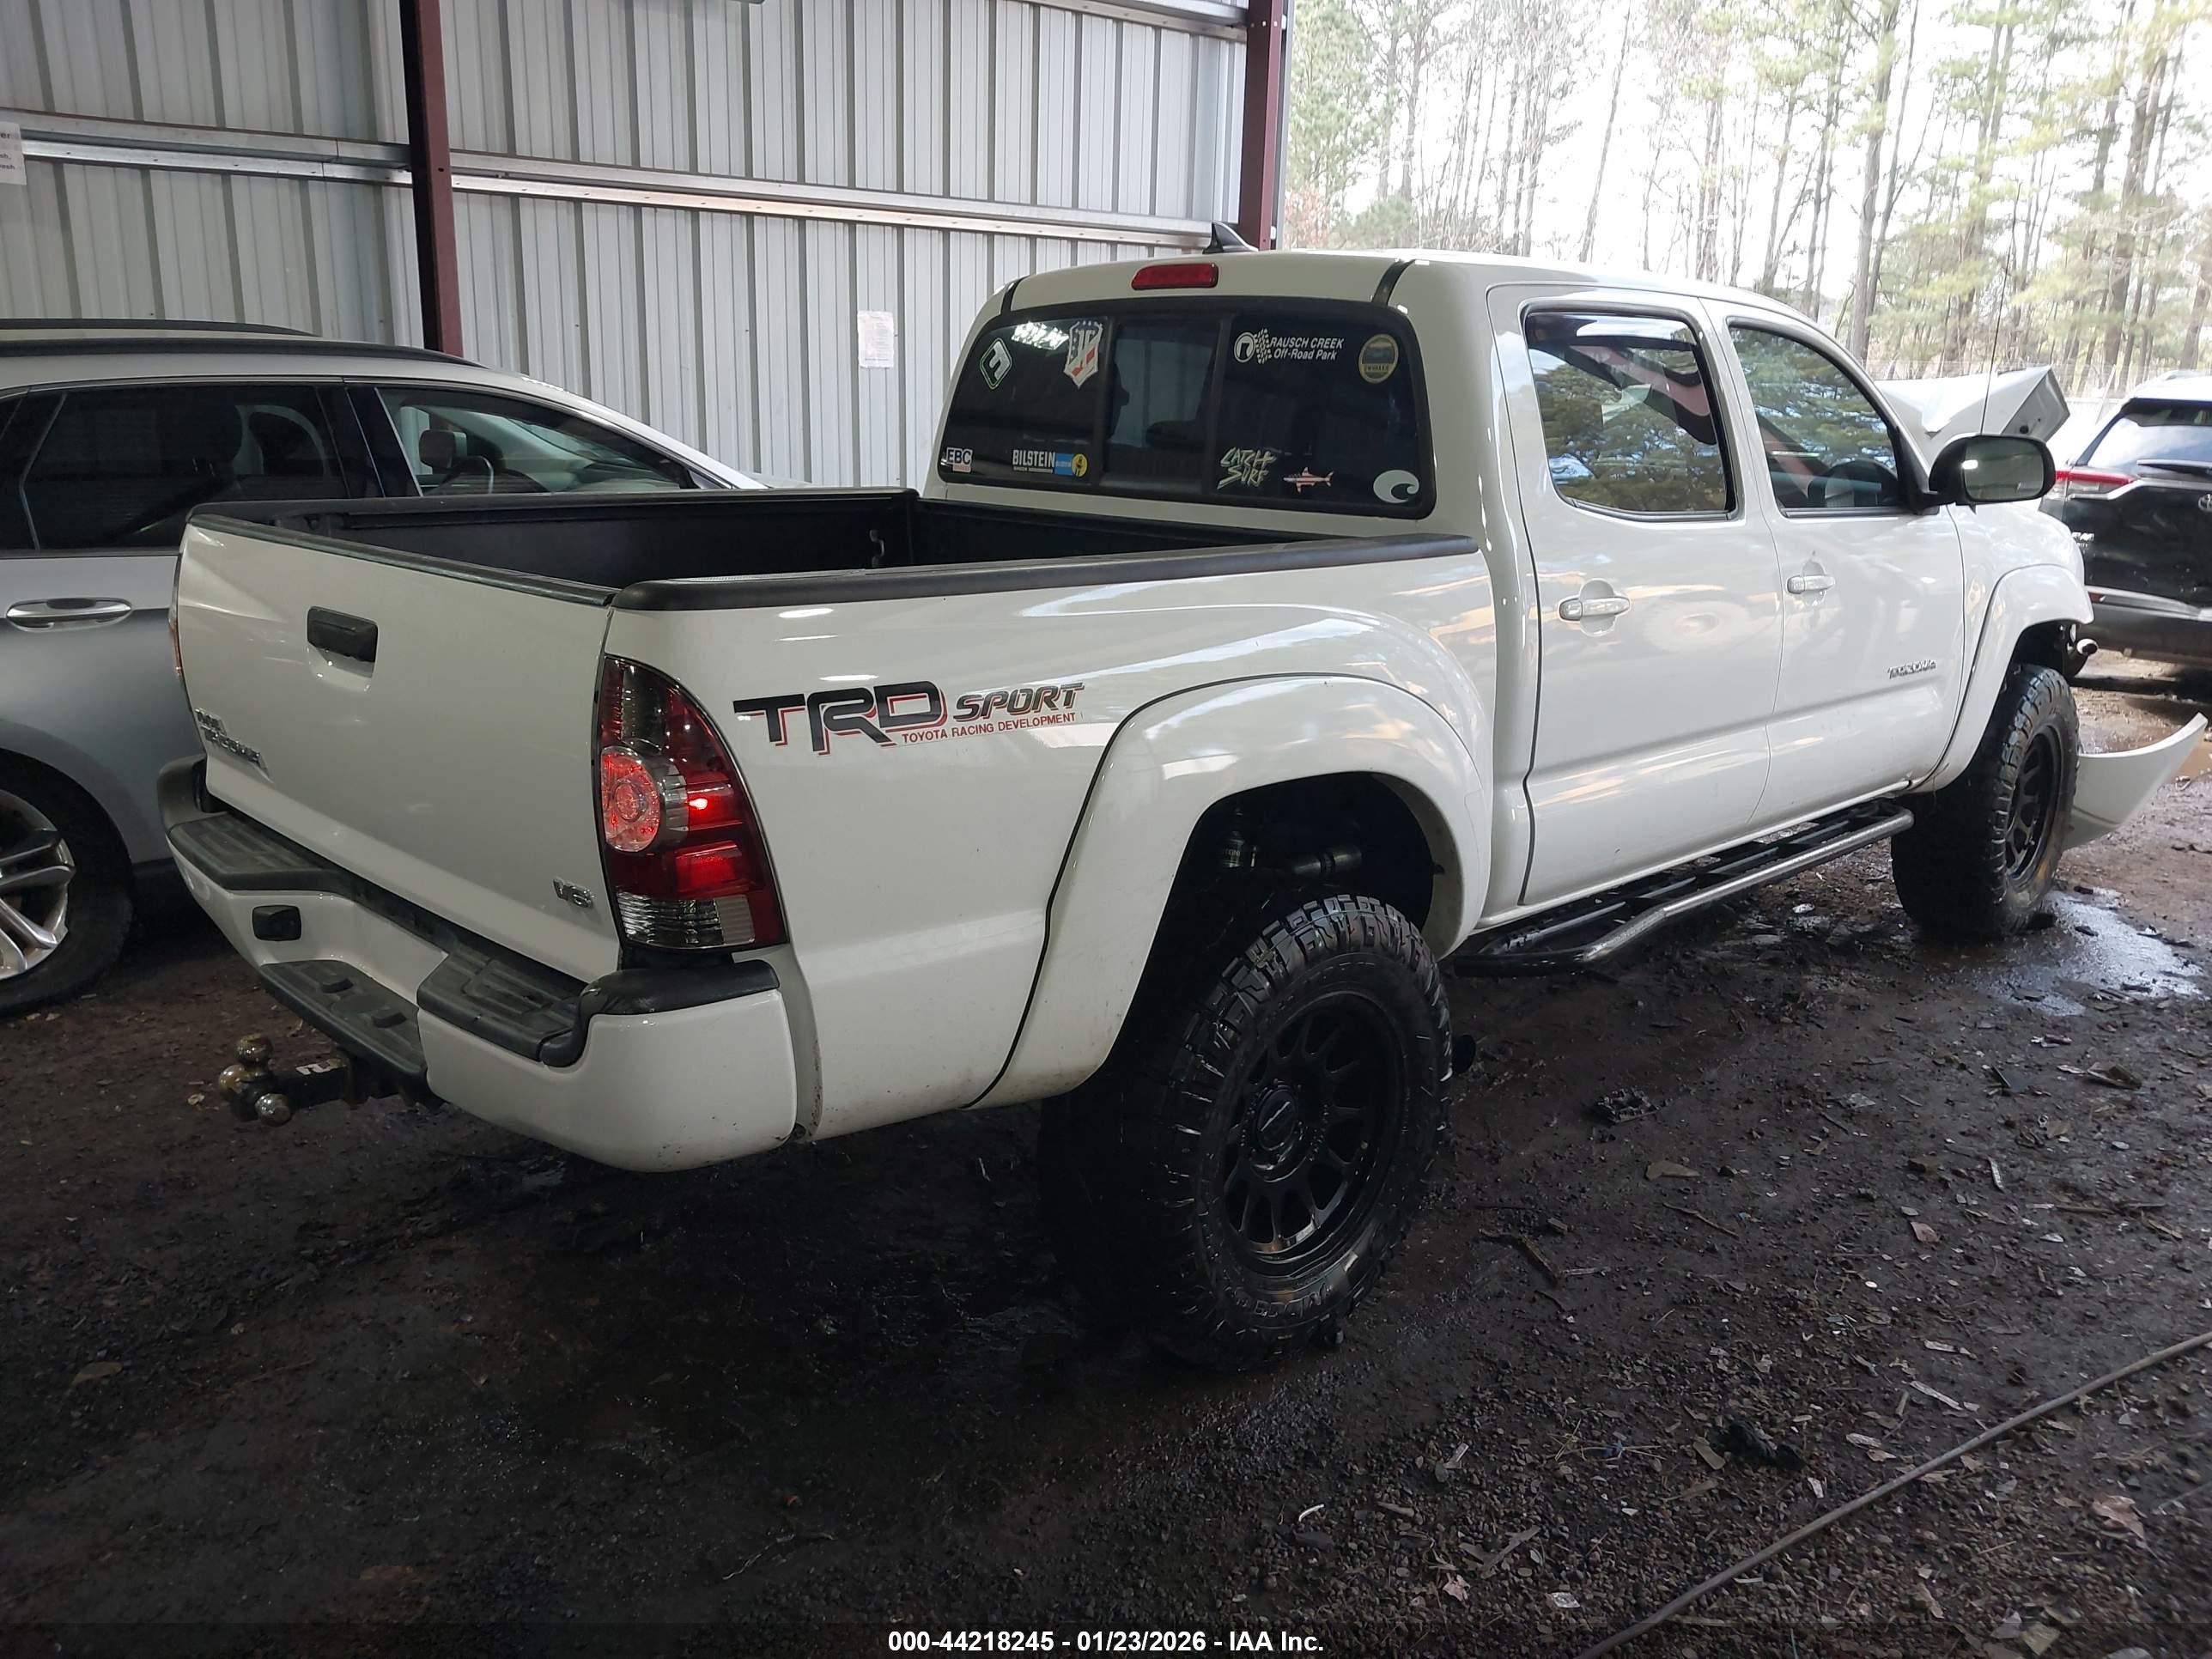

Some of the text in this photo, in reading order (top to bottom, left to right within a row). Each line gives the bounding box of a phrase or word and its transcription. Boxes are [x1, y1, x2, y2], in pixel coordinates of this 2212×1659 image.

[1271, 337, 1344, 349] RAUSCH CREEK
[1273, 348, 1337, 361] Off-Road Park
[947, 449, 971, 465] EBC
[1012, 449, 1056, 468] BILSTEIN
[733, 680, 1085, 757] TRD SPORT
[901, 713, 1077, 744] TOYOTA RACING DEVELOPMENT
[553, 878, 592, 908] V6
